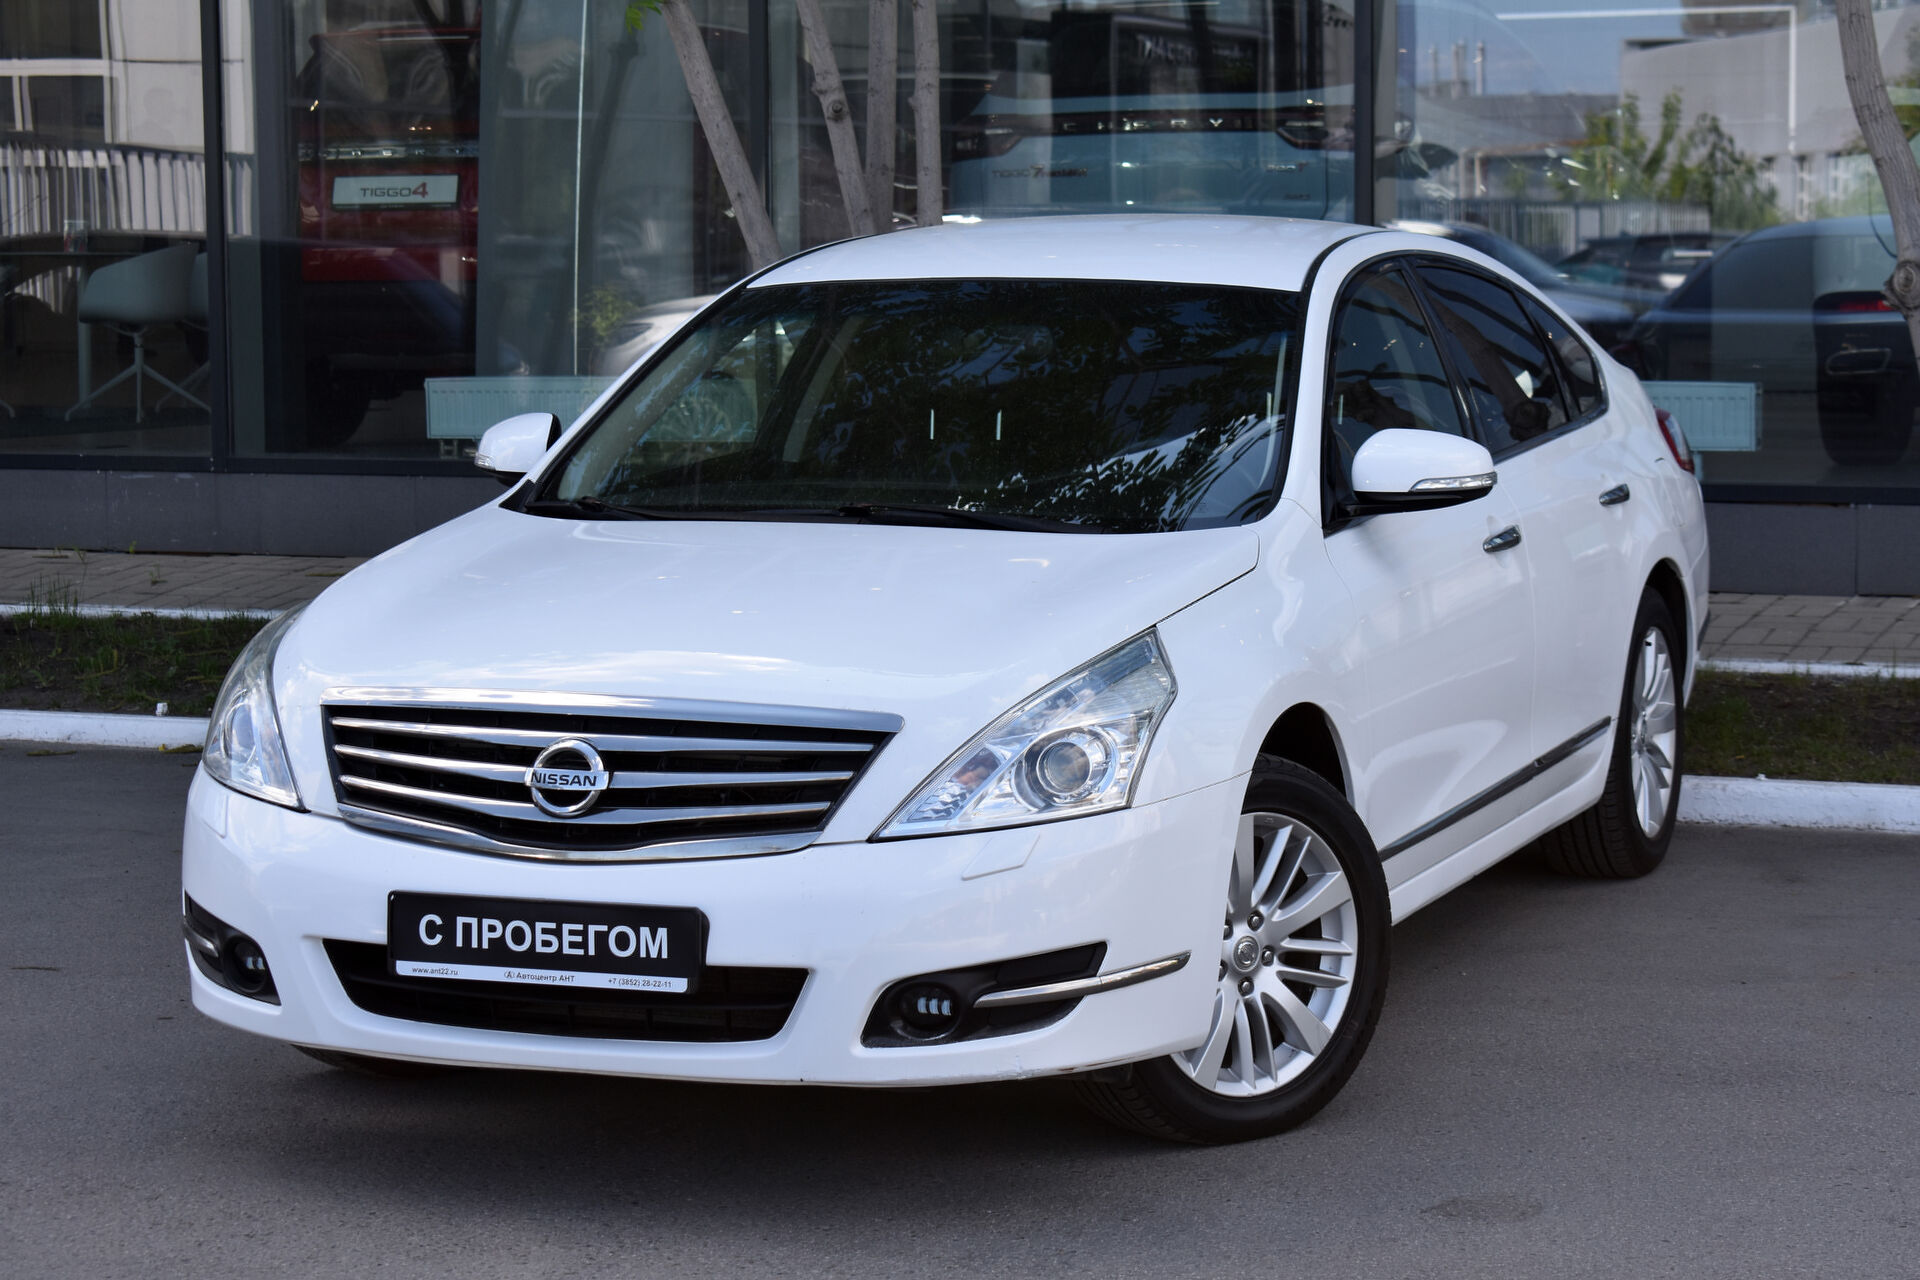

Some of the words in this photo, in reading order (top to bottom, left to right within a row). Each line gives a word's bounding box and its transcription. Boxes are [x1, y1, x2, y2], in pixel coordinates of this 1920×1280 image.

[530, 770, 597, 787] NISSAN
[418, 914, 443, 946] С
[456, 916, 668, 959] ПРОБЕГОМ
[411, 966, 459, 976] www.ant22.ru
[517, 972, 558, 982] Автоцентр
[559, 974, 575, 983] АНТ
[618, 978, 640, 987] (3852)
[642, 979, 672, 988] 28-22-11
